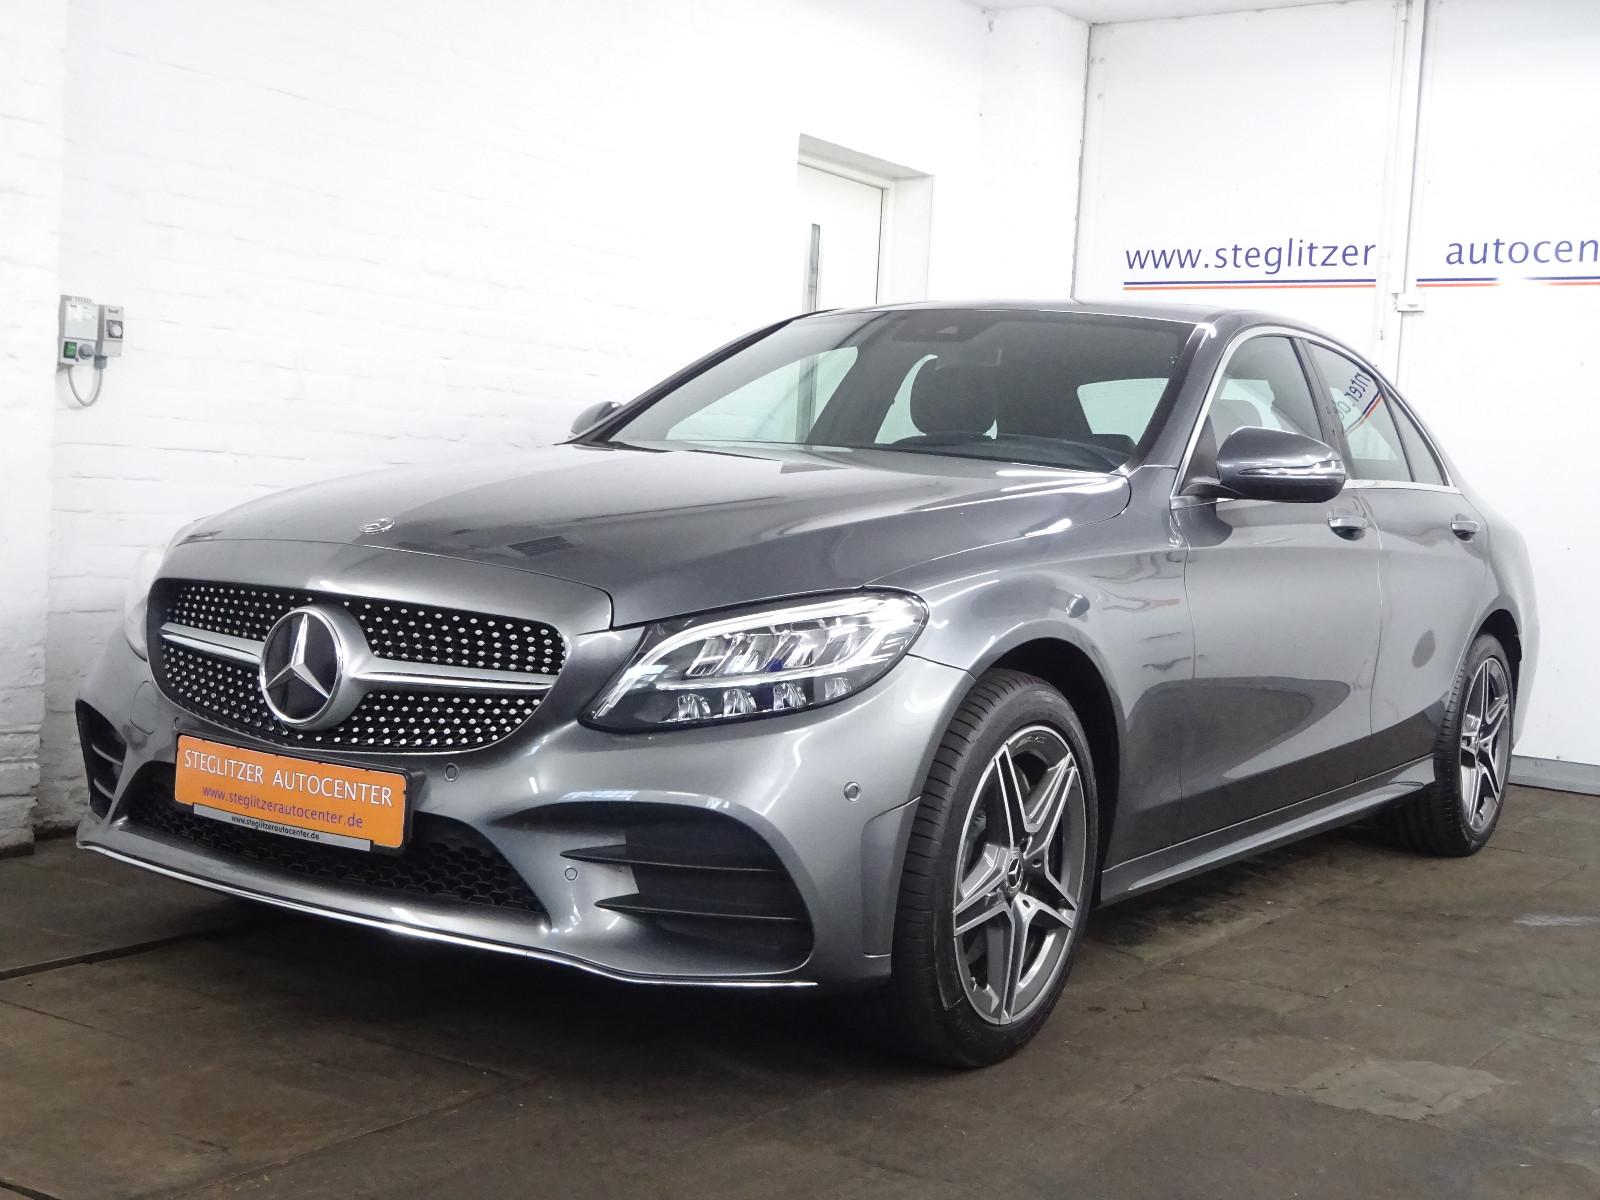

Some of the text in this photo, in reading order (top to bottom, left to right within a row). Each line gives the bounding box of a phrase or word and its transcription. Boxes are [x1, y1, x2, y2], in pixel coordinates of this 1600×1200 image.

[1125, 238, 1600, 275] www.steglitzer autocen
[184, 749, 393, 807] STEGLITZER AUTOCENTER
[201, 786, 364, 829] www.steglitzerautocenter.de
[231, 815, 320, 841] www.steglitzerautocenter.de
